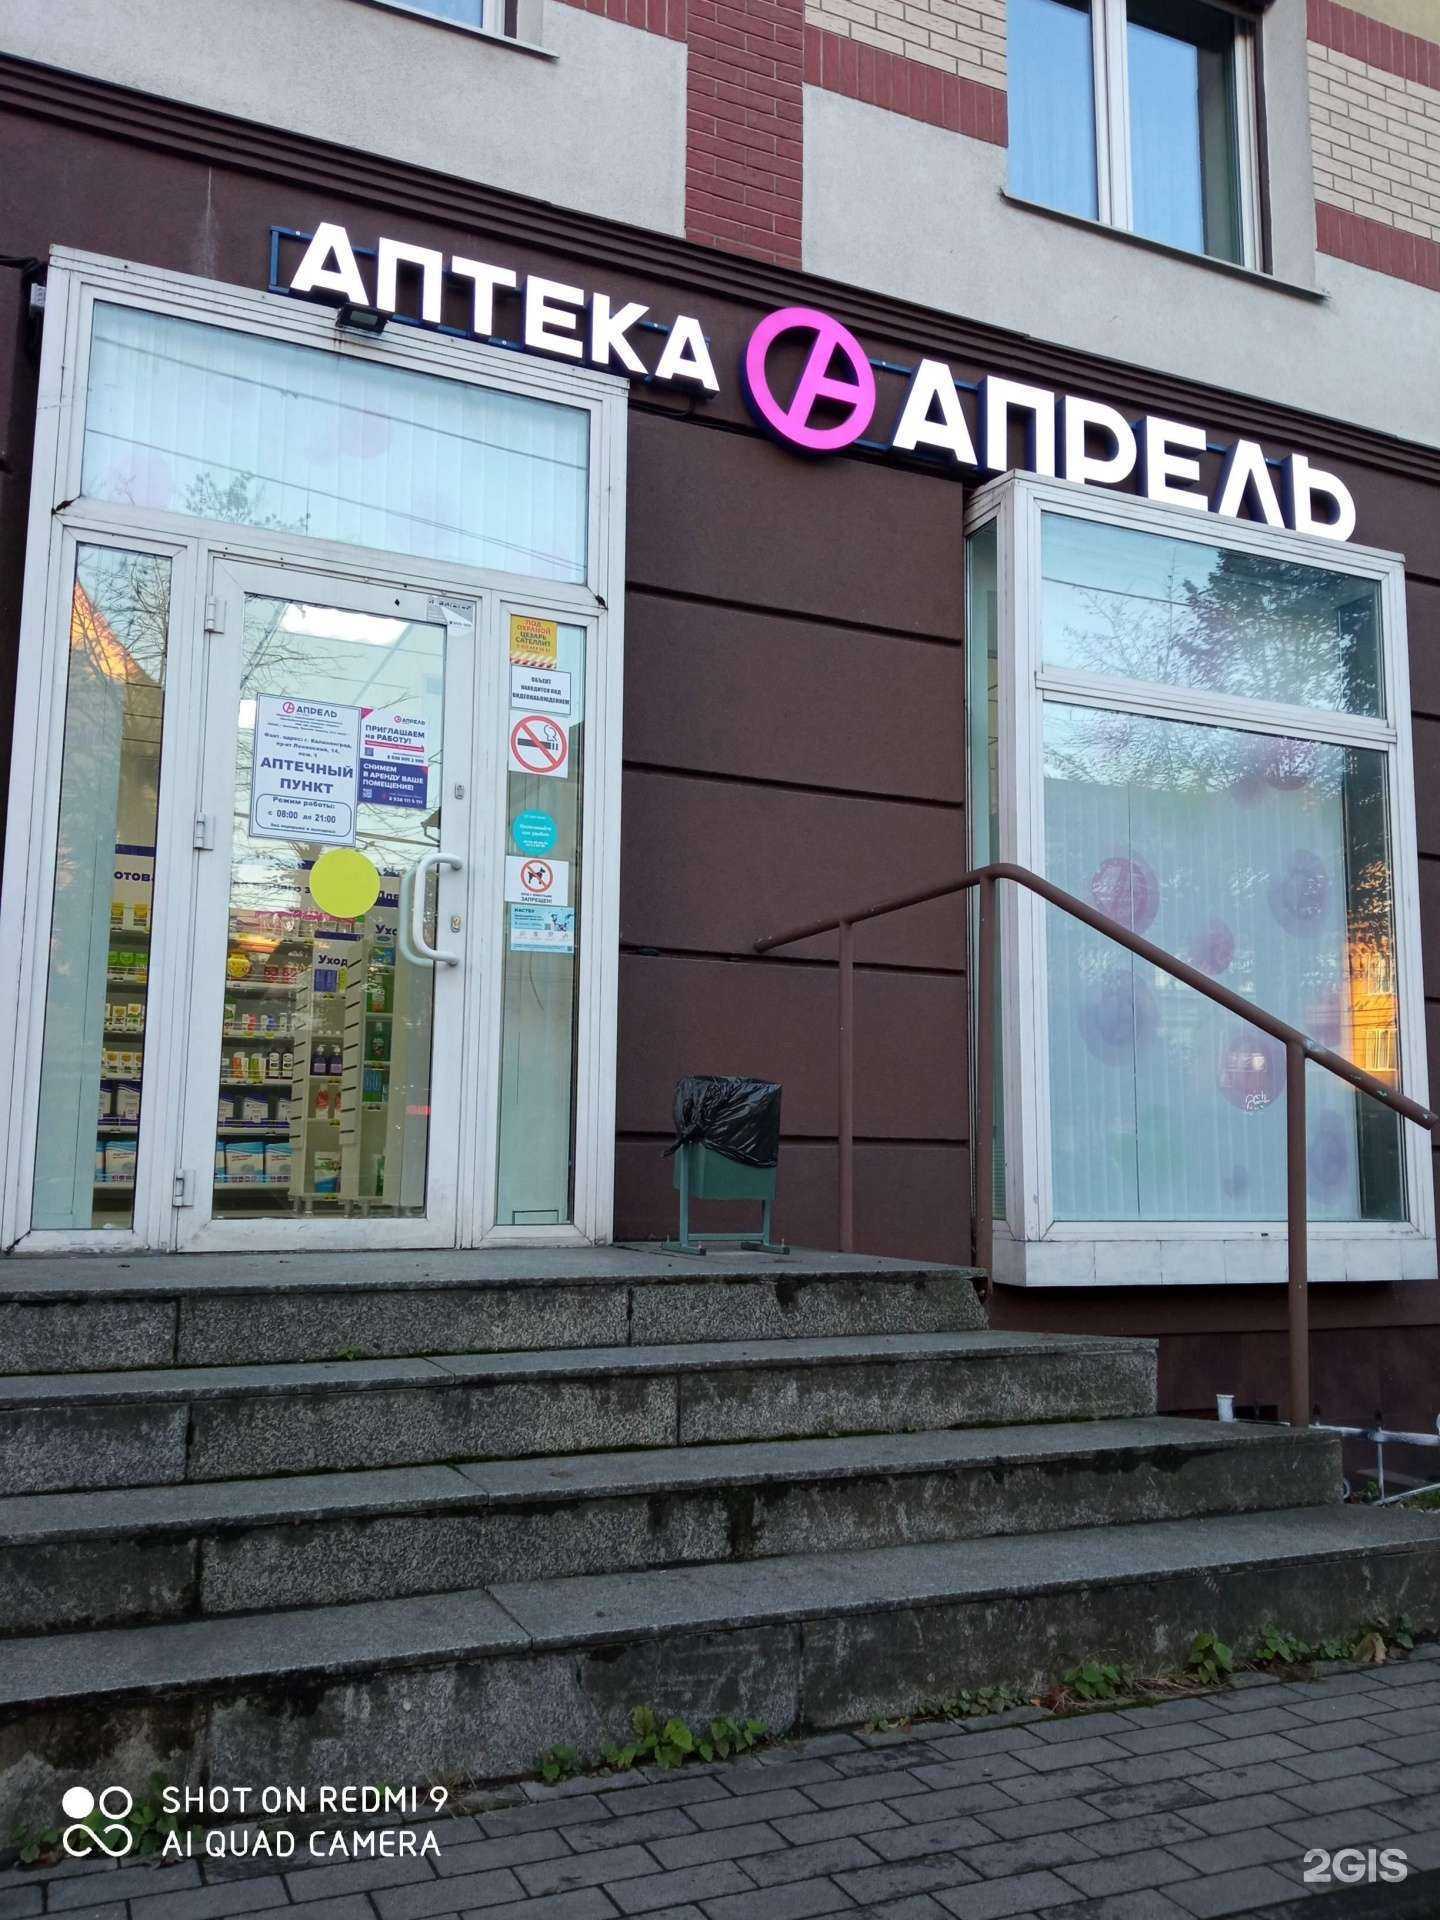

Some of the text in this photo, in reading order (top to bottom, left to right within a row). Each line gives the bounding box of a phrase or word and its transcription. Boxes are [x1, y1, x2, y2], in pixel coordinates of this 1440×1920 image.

[289, 223, 1357, 542] АПТЕКА АПРЕЛЬ
[296, 706, 338, 718] АПРЕЛЬ
[365, 724, 425, 738] ПРИГЛАШАЕМ
[376, 734, 412, 745] РАБОТУ!
[260, 757, 354, 778] АПТЕЧНЫЙ
[363, 763, 397, 773] СНИМЕМ
[370, 772, 401, 781] АРЕНДУ
[280, 778, 334, 794] ПУНКТ
[272, 796, 301, 805] Режим
[276, 810, 298, 819] 08:00
[314, 814, 336, 824] 21:00
[318, 954, 348, 967] Уход
